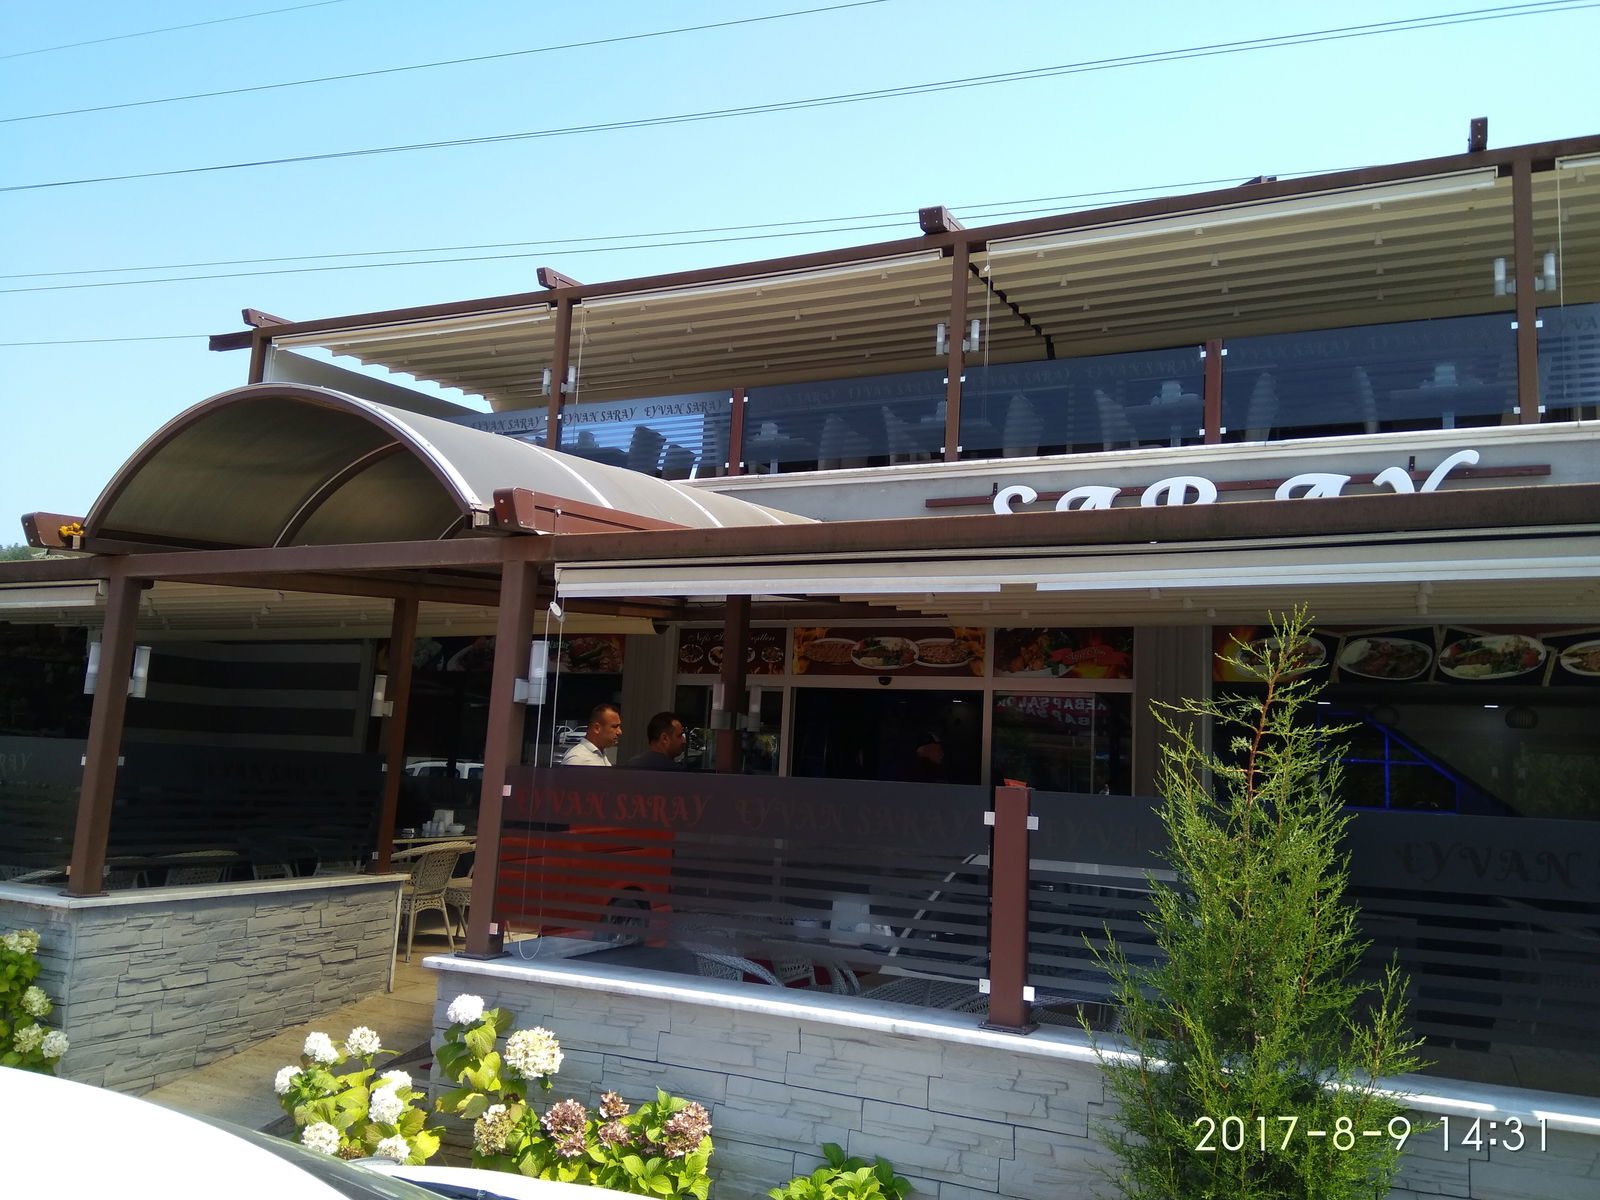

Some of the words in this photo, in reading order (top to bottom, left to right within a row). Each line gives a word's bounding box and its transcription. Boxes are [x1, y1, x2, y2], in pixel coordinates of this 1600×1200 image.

[508, 415, 544, 431] SARAY
[561, 412, 599, 427] EYVAN
[600, 407, 639, 423] SARAY
[645, 403, 684, 418] EYVAN
[684, 399, 723, 415] SARAY
[515, 787, 610, 820] EYVAN
[614, 793, 714, 828] SARAY
[735, 795, 848, 833] EYVAN
[1393, 840, 1583, 888] EYVAN
